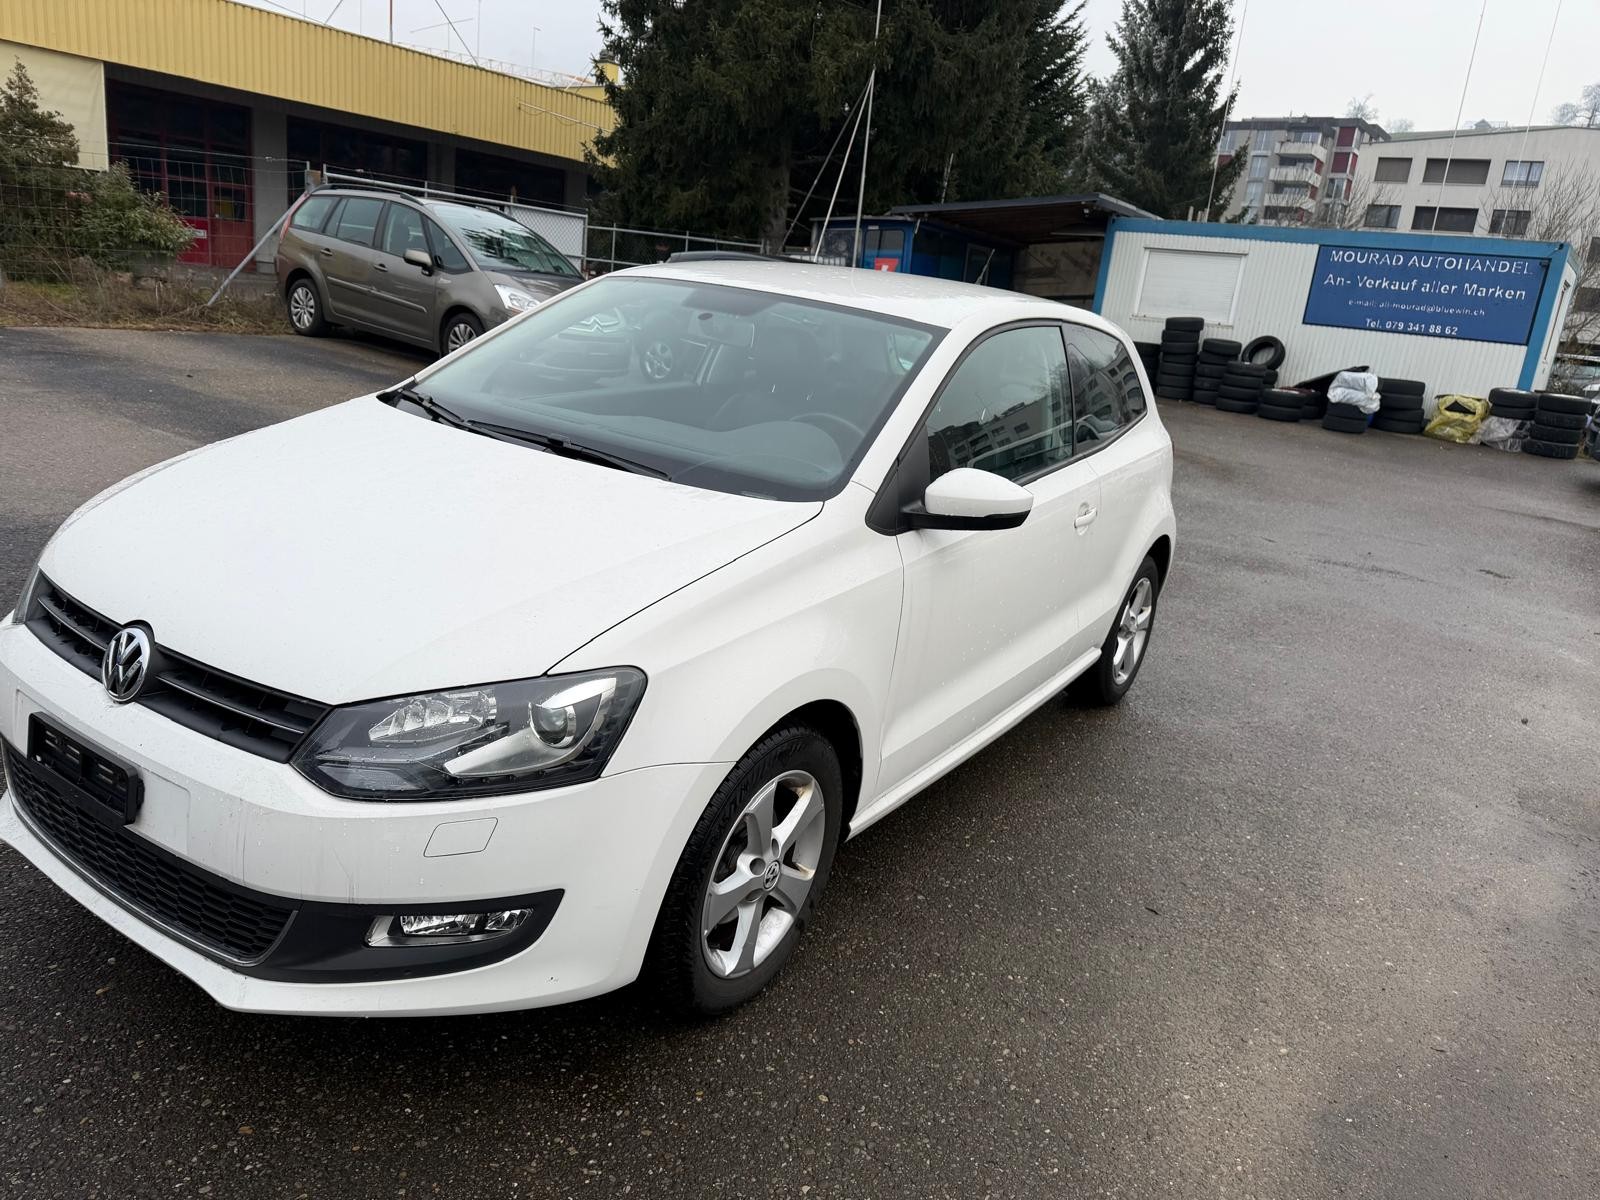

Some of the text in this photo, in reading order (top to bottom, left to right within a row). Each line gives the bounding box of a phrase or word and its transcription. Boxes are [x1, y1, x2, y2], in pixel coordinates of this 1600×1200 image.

[1330, 250, 1534, 275] MOURAD AUTOHANDEL
[1323, 273, 1527, 300] An- Verkauf aller Marken
[1365, 318, 1459, 336] Tel. 079 341 88 62
[104, 629, 148, 699] VW
